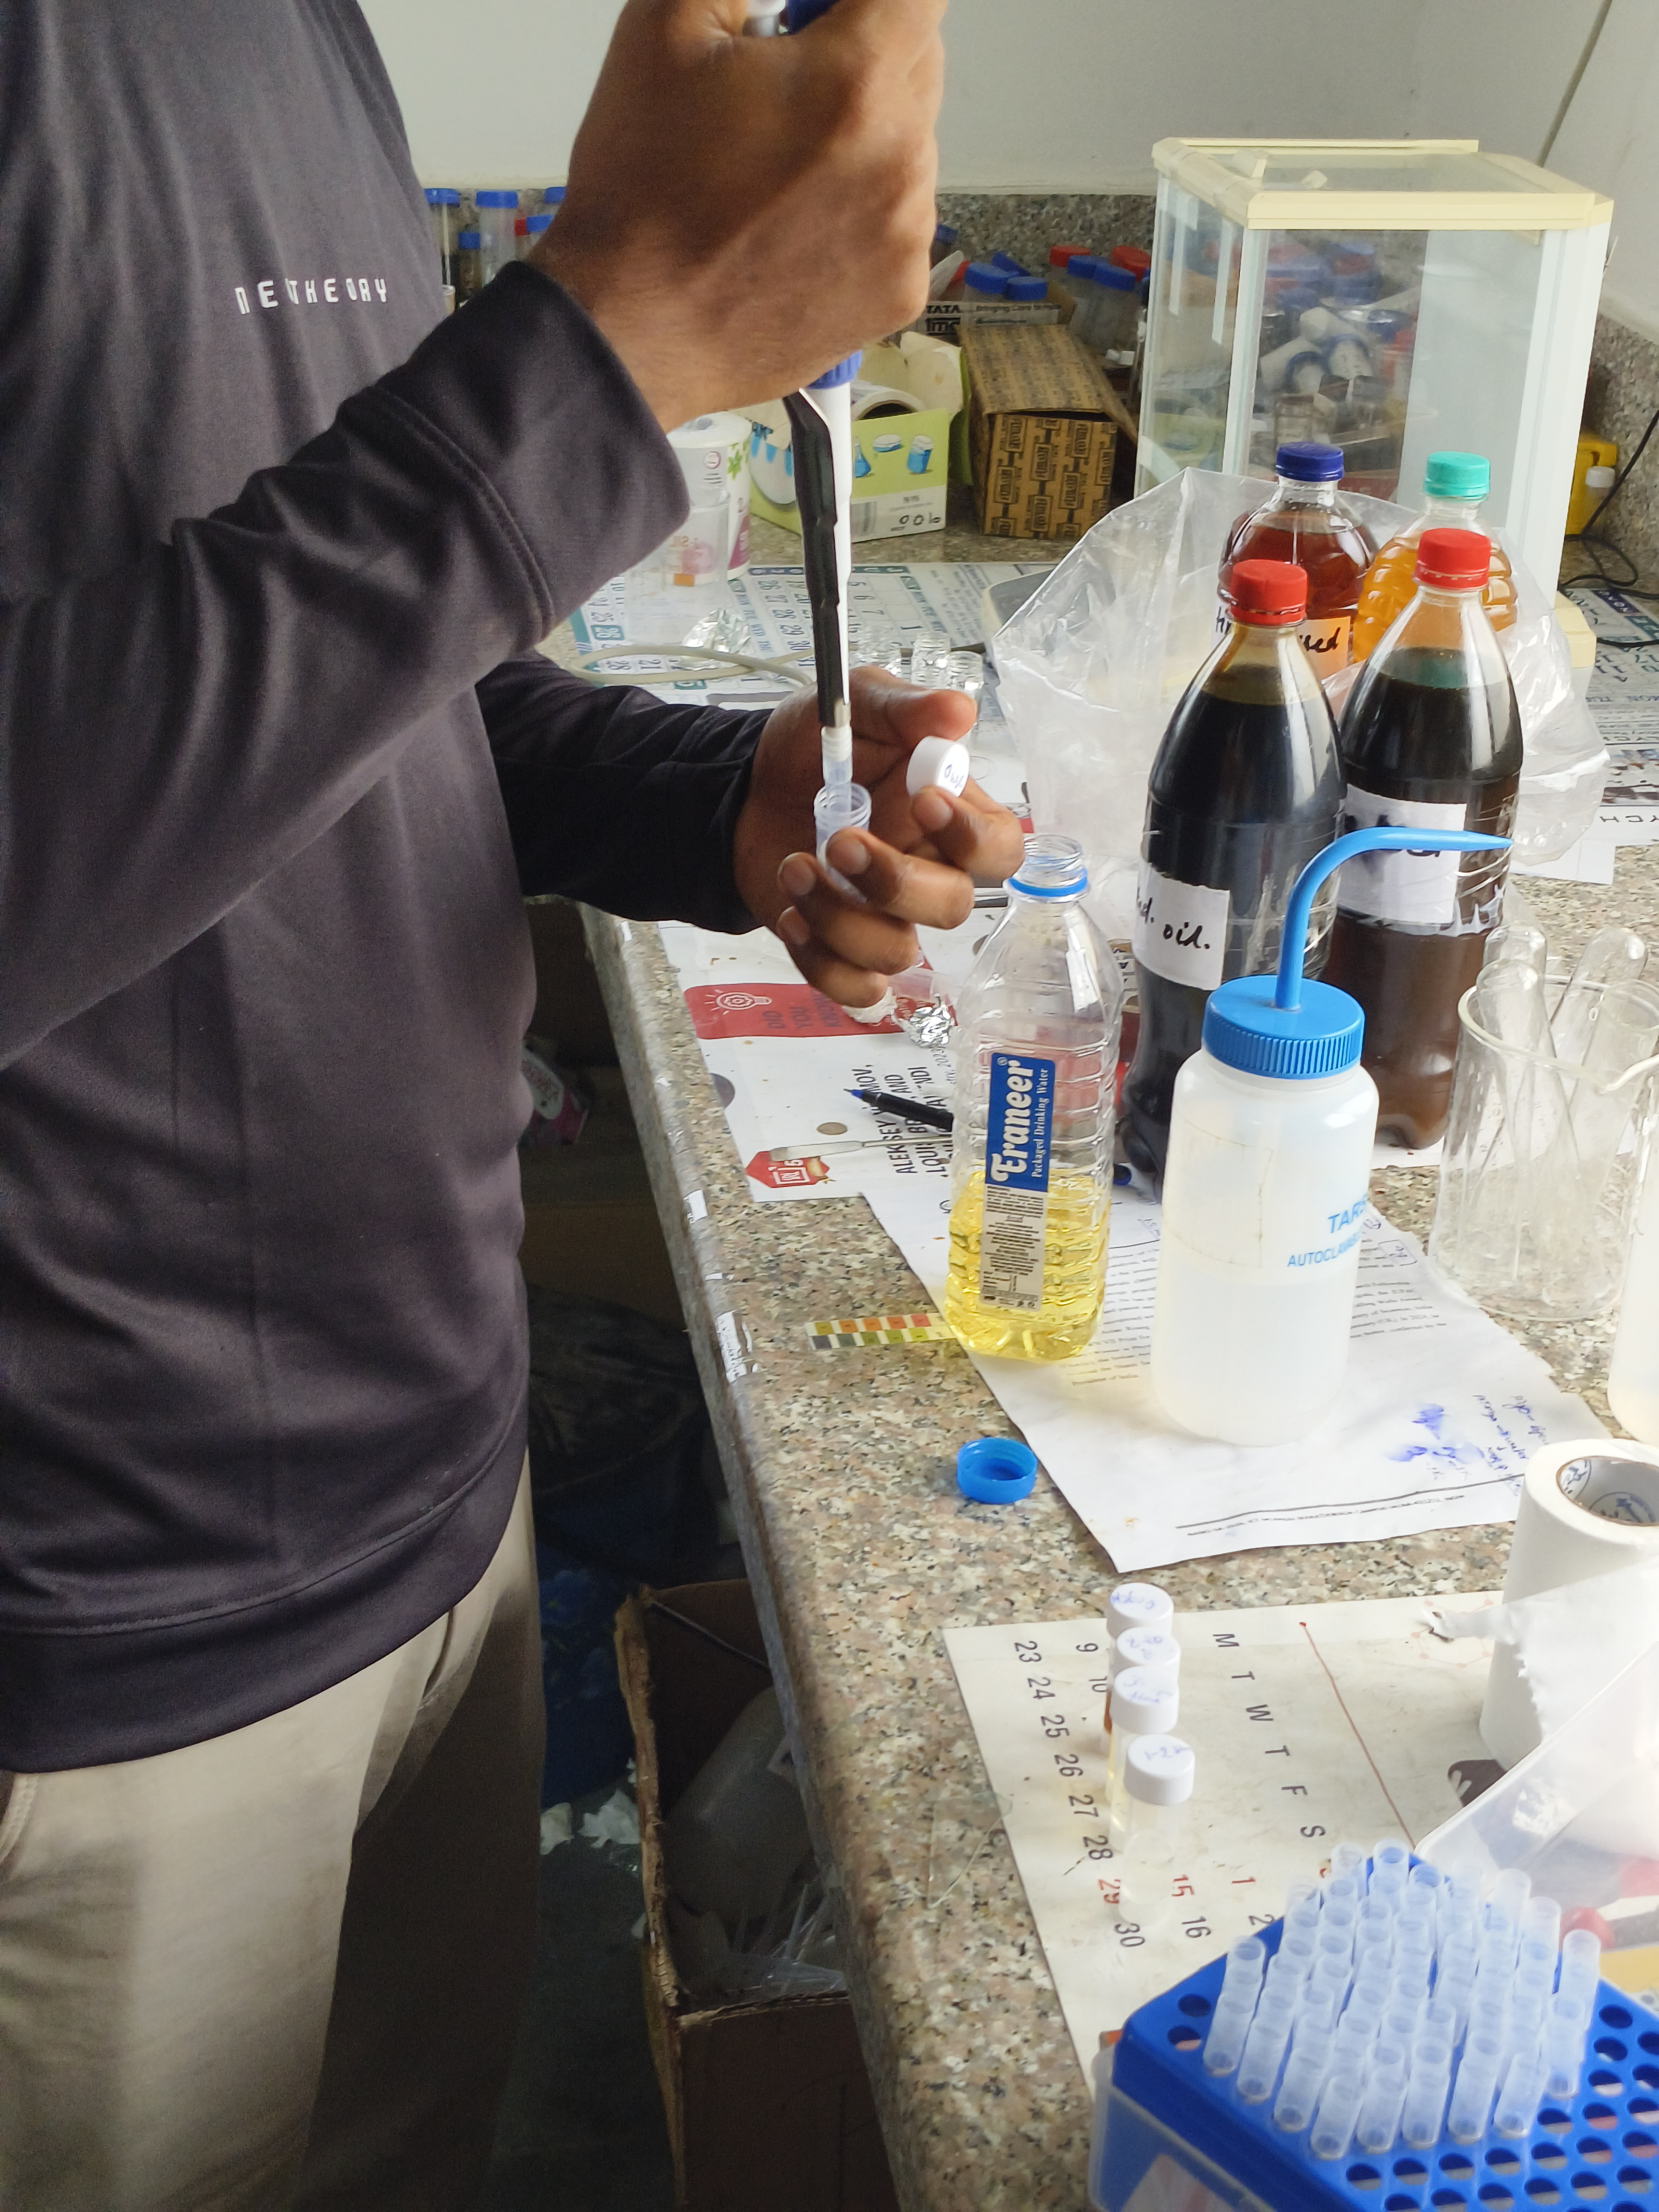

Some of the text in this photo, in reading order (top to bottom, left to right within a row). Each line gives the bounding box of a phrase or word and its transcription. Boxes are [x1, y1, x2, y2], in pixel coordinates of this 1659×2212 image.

[765, 595, 789, 603] 27
[772, 609, 797, 619] 28
[779, 625, 805, 636] 29
[787, 640, 812, 651] 30
[606, 659, 632, 671] 28
[639, 659, 664, 670] 21
[1163, 921, 1211, 949] oil.
[884, 1074, 913, 1094] AND
[1031, 1068, 1050, 1178] Packaged Drinking Water
[1014, 1640, 1042, 1664] 23
[1076, 1643, 1098, 1654] 9
[1028, 1677, 1056, 1701] 24
[1041, 1714, 1070, 1739] 25
[1212, 1633, 1326, 1838] M T W T F S
[1054, 1753, 1084, 1778] 26
[1068, 1794, 1099, 1819] 27
[1082, 1835, 1114, 1861] 28
[1171, 1874, 1195, 1897] 15
[1231, 1877, 1256, 1885] 1
[1114, 1922, 1145, 1947] 30
[1181, 1915, 1212, 1938] 16
